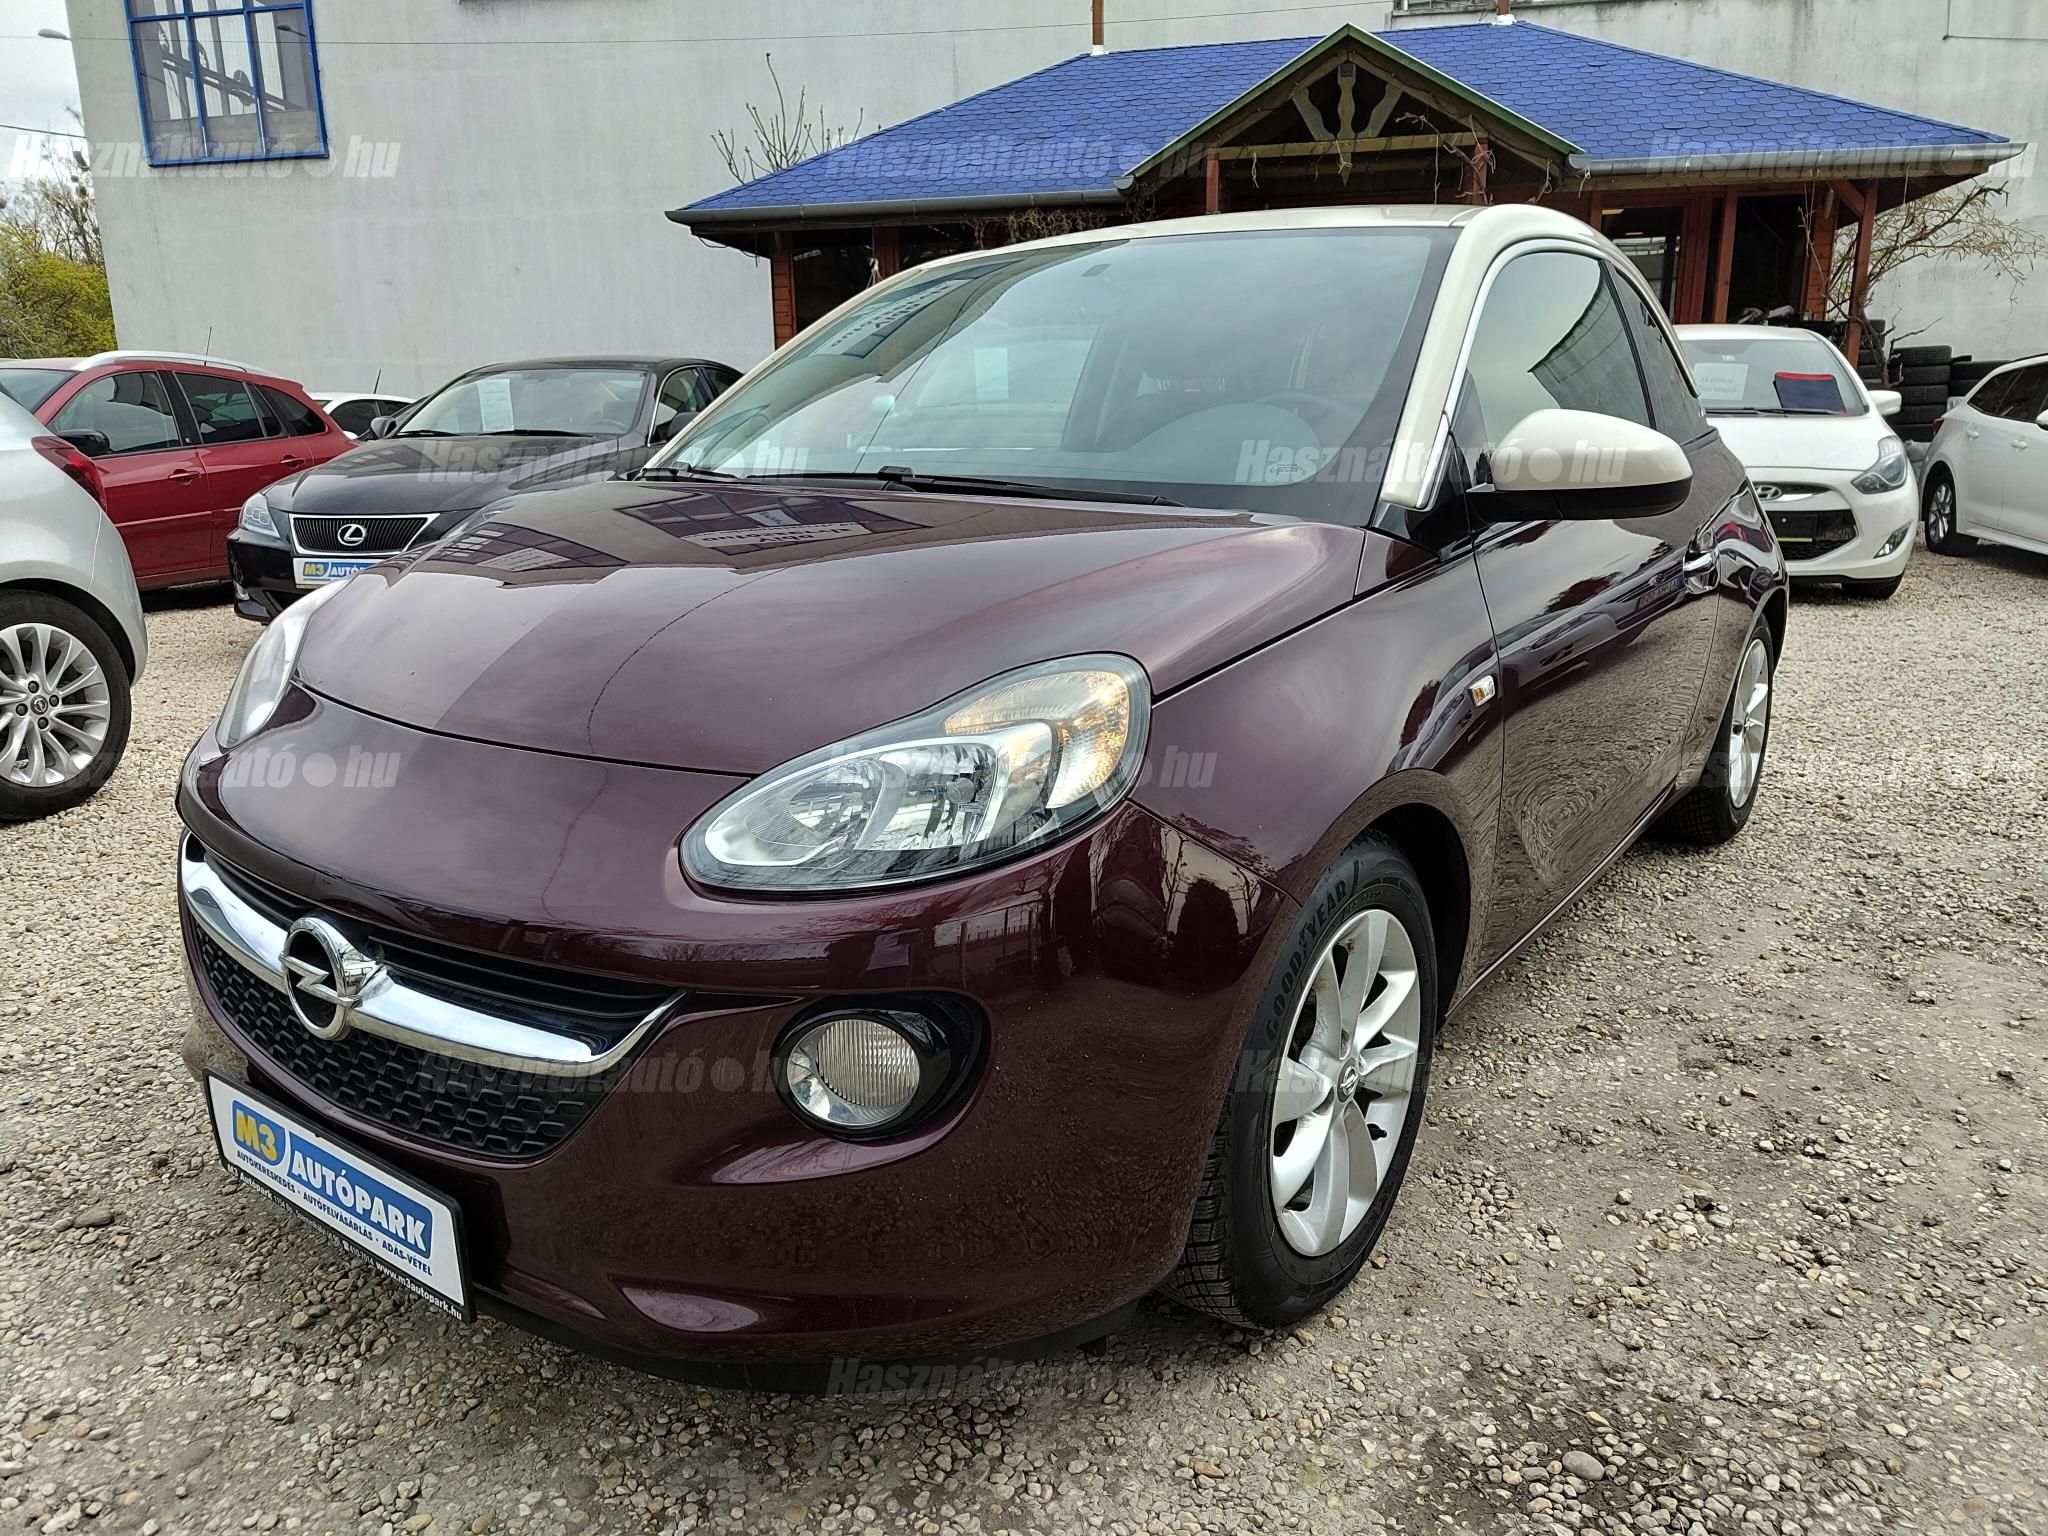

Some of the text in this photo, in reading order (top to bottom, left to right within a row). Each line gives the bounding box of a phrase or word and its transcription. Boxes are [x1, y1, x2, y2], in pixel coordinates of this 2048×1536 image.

[305, 563, 325, 576] M3
[1264, 879, 1348, 1042] GOODYEAR
[236, 1109, 278, 1162] M3
[292, 1149, 426, 1252] AUTÓPARK
[303, 1192, 374, 1241] AUTÓFELVÁSÁRLÁS
[381, 1240, 433, 1277] ADÁS-VÉTEL
[375, 1261, 462, 1321] www.m3autopark.hu
